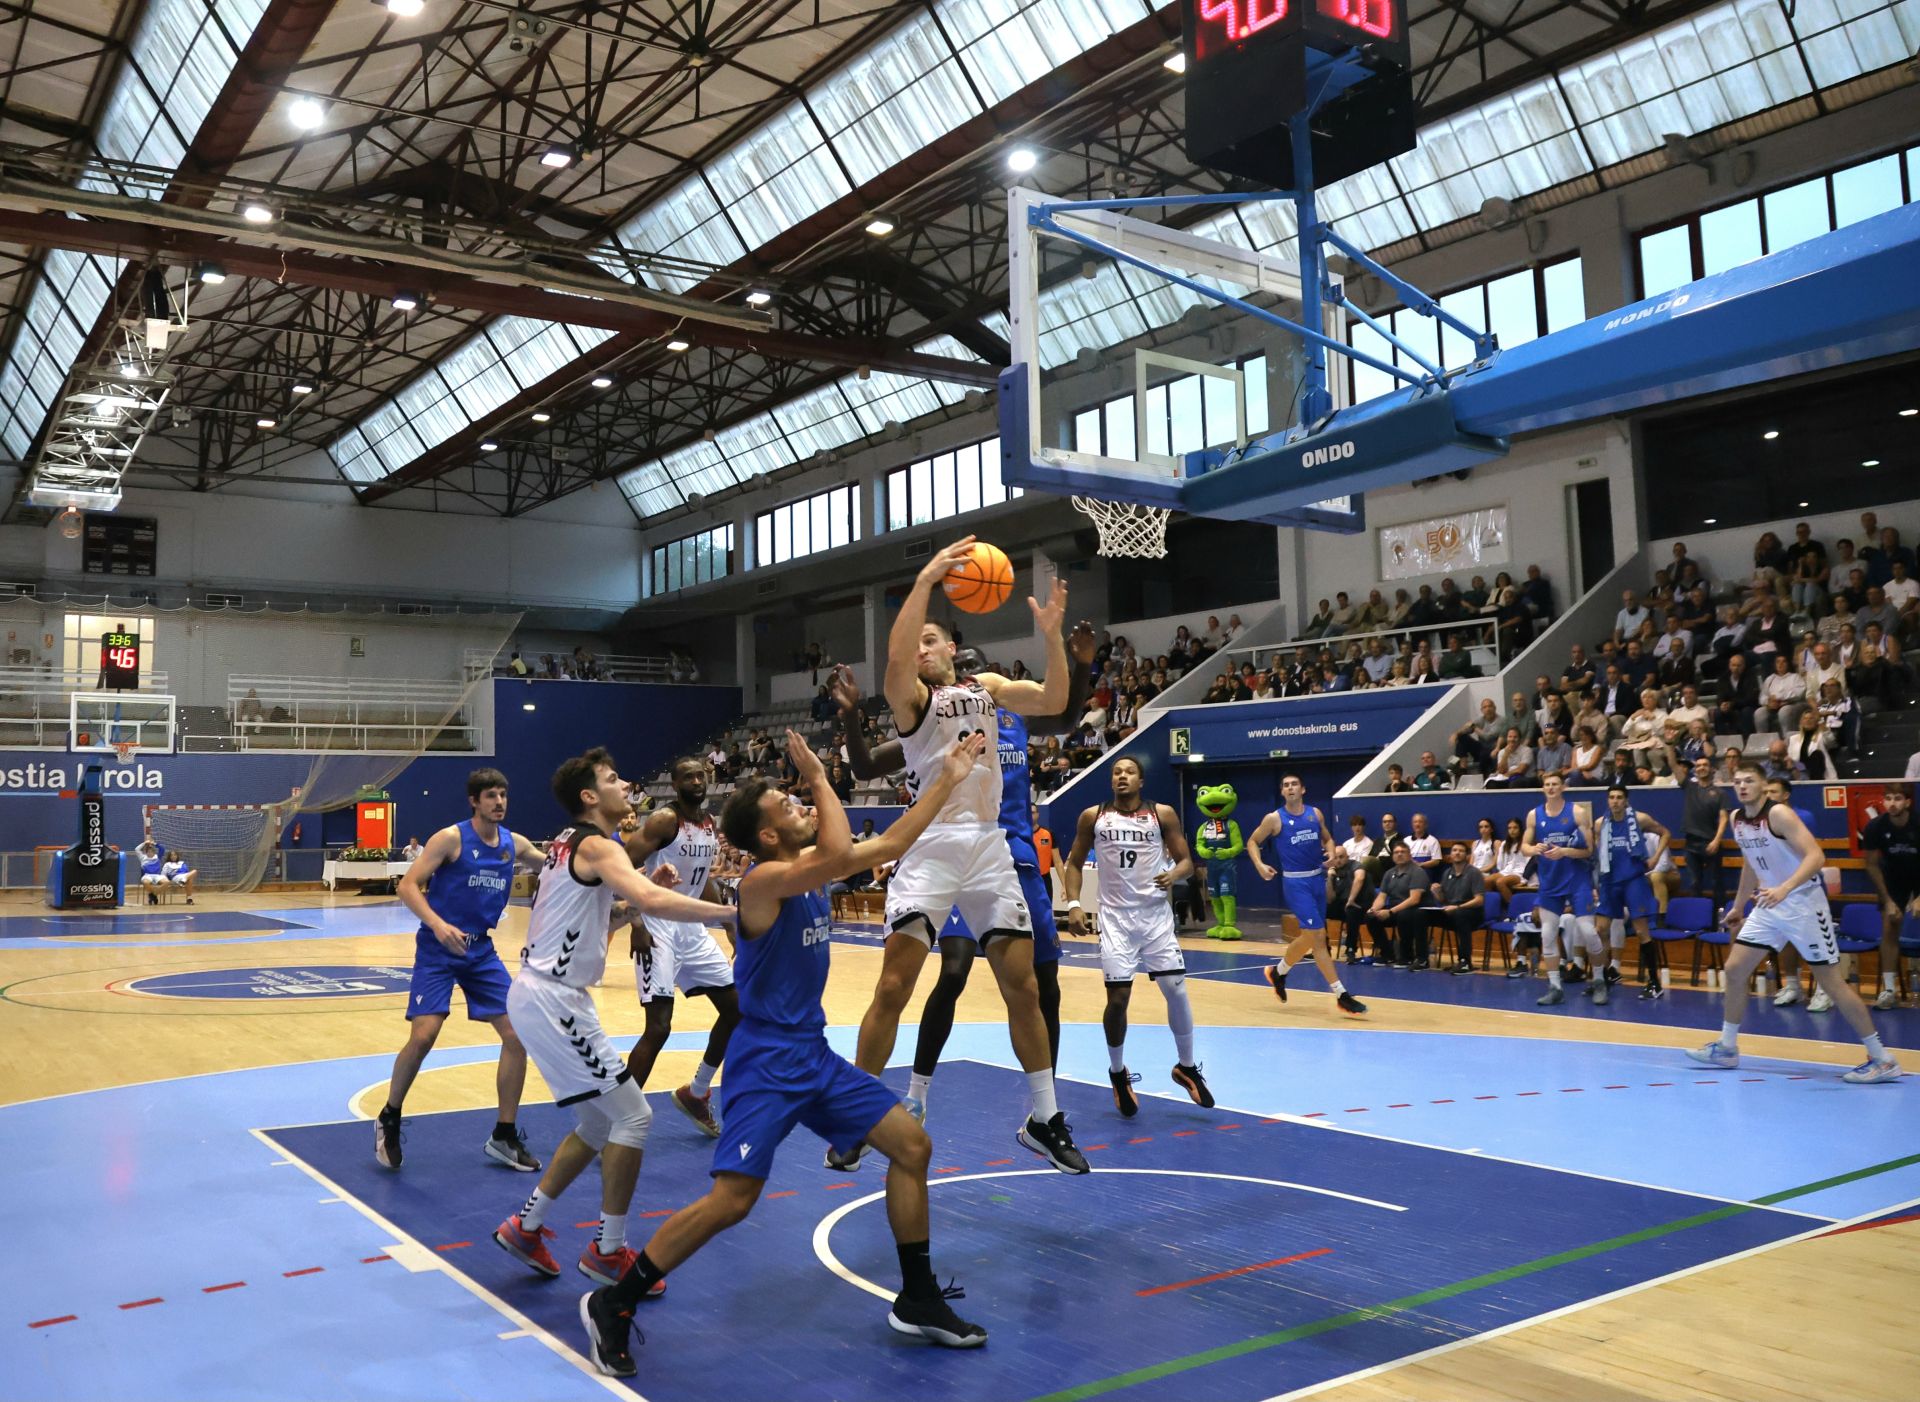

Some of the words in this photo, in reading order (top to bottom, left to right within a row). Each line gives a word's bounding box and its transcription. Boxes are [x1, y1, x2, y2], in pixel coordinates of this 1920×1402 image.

[1603, 294, 1689, 331] MONDO
[1302, 441, 1355, 468] ONDO
[79, 802, 103, 866] pressing
[1099, 829, 1155, 842] surne
[1119, 850, 1138, 869] 19
[690, 867, 706, 886] 17
[70, 883, 114, 899] pressing
